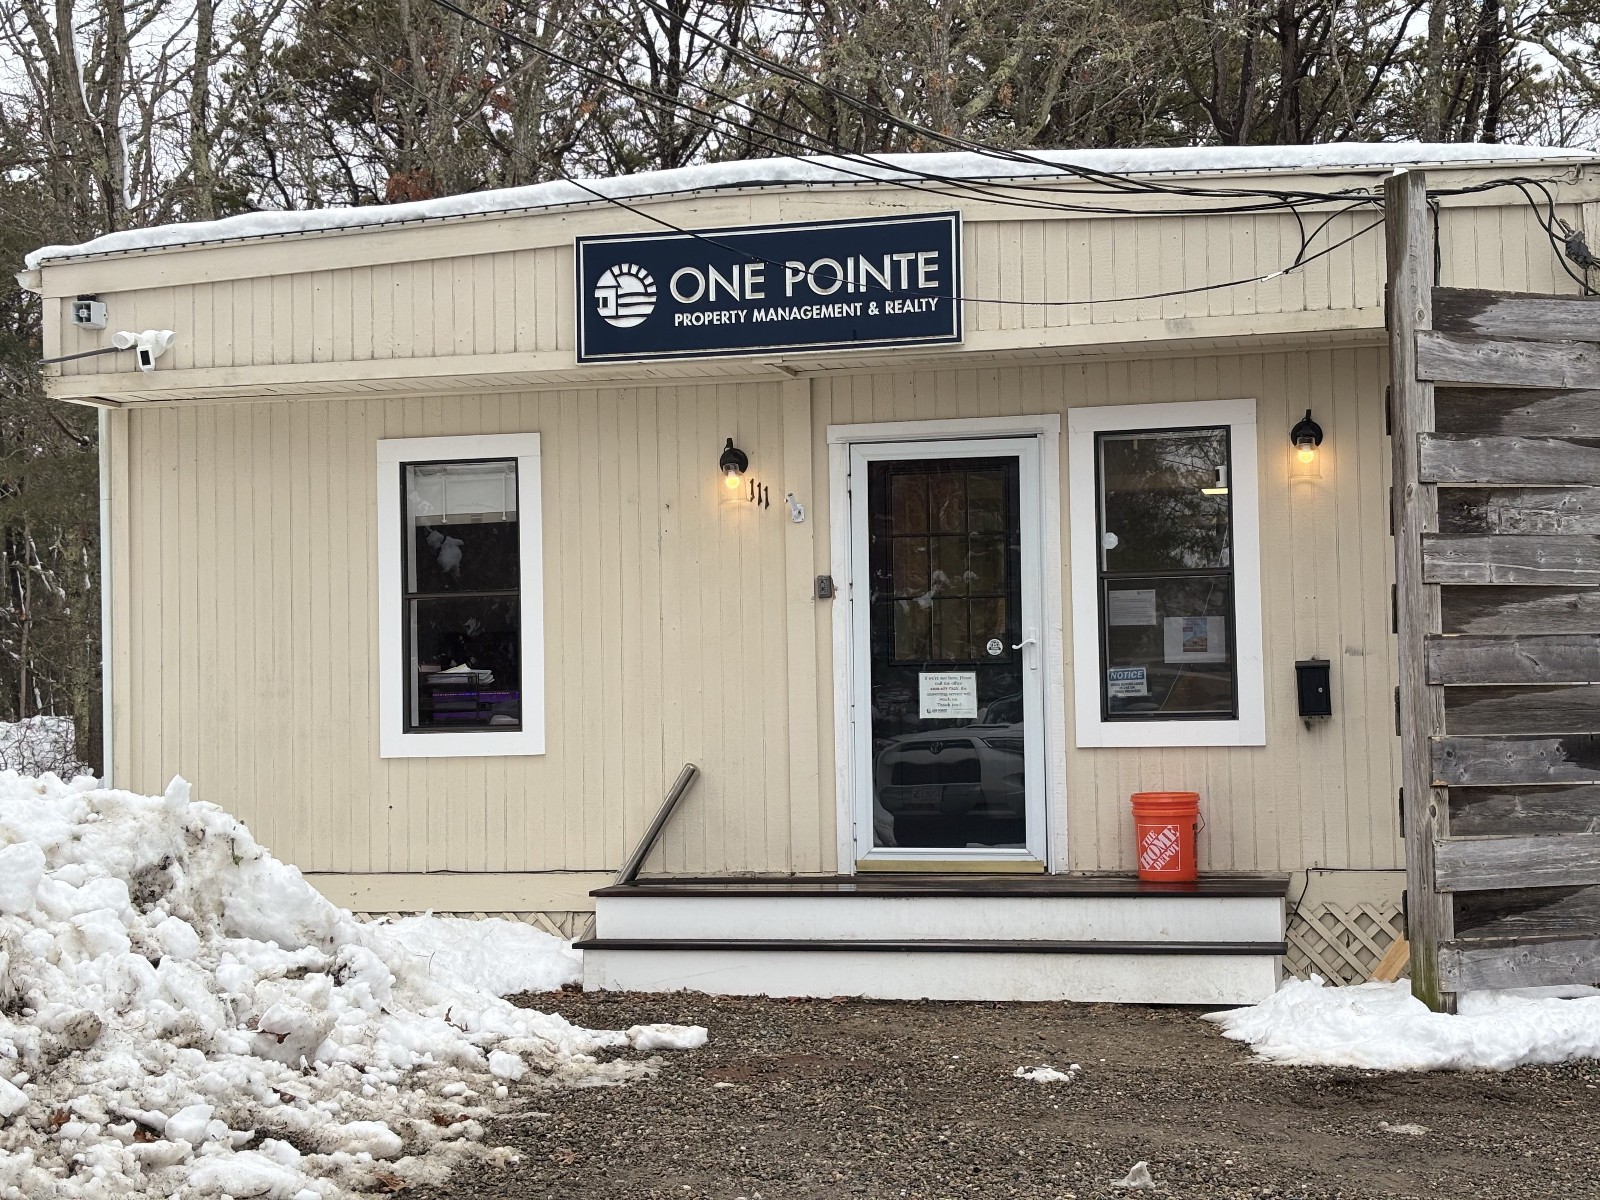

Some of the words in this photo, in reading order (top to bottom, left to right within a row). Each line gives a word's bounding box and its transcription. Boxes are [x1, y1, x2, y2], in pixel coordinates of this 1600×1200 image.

[670, 262, 765, 304] ONE
[785, 250, 939, 297] POINTE
[674, 309, 748, 327] PROPERTY
[752, 302, 863, 323] MANAGEMENT
[868, 301, 880, 315] &
[885, 297, 939, 315] REALTY
[749, 477, 770, 510] 111
[1110, 671, 1144, 680] NOTICE
[1141, 825, 1179, 870] HOME
[1142, 830, 1157, 848] THE
[1153, 842, 1179, 870] DEPOT
